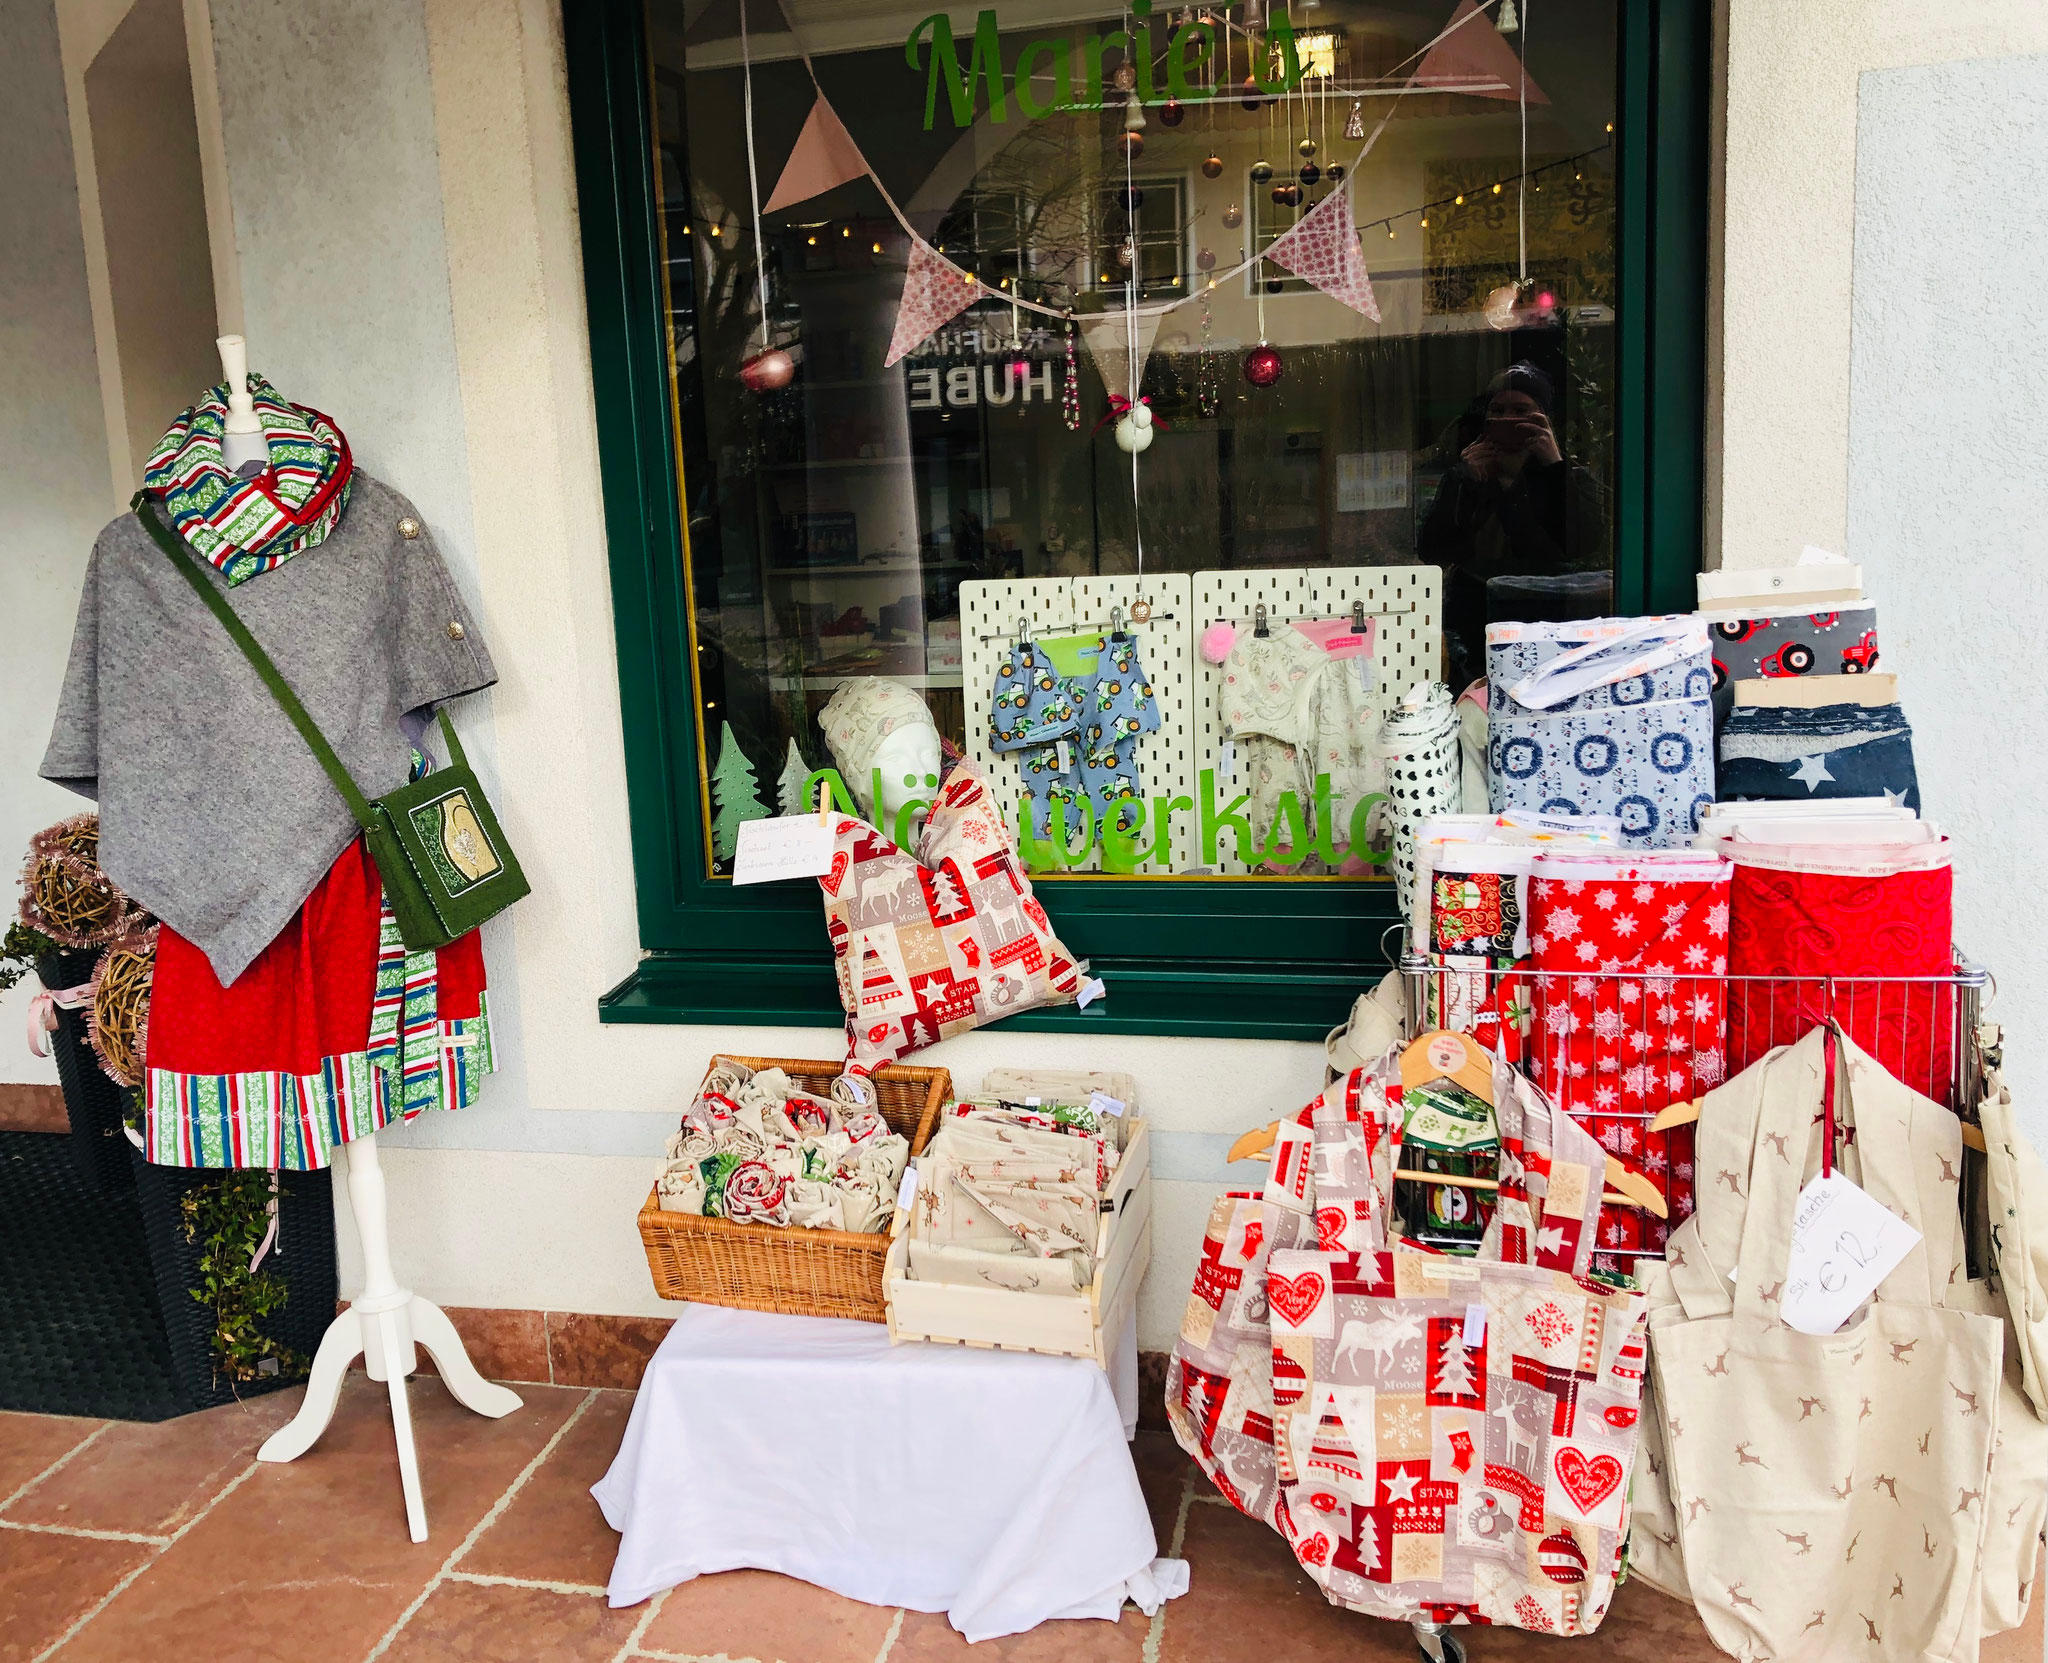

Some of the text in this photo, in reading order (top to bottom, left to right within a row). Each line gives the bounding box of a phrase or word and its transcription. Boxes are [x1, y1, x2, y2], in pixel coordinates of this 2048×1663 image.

[899, 911, 928, 923] Moose
[950, 983, 977, 998] STAR
[1205, 1265, 1238, 1286] STAR
[1384, 1379, 1425, 1392] Moose
[1419, 1487, 1455, 1500] STAR
